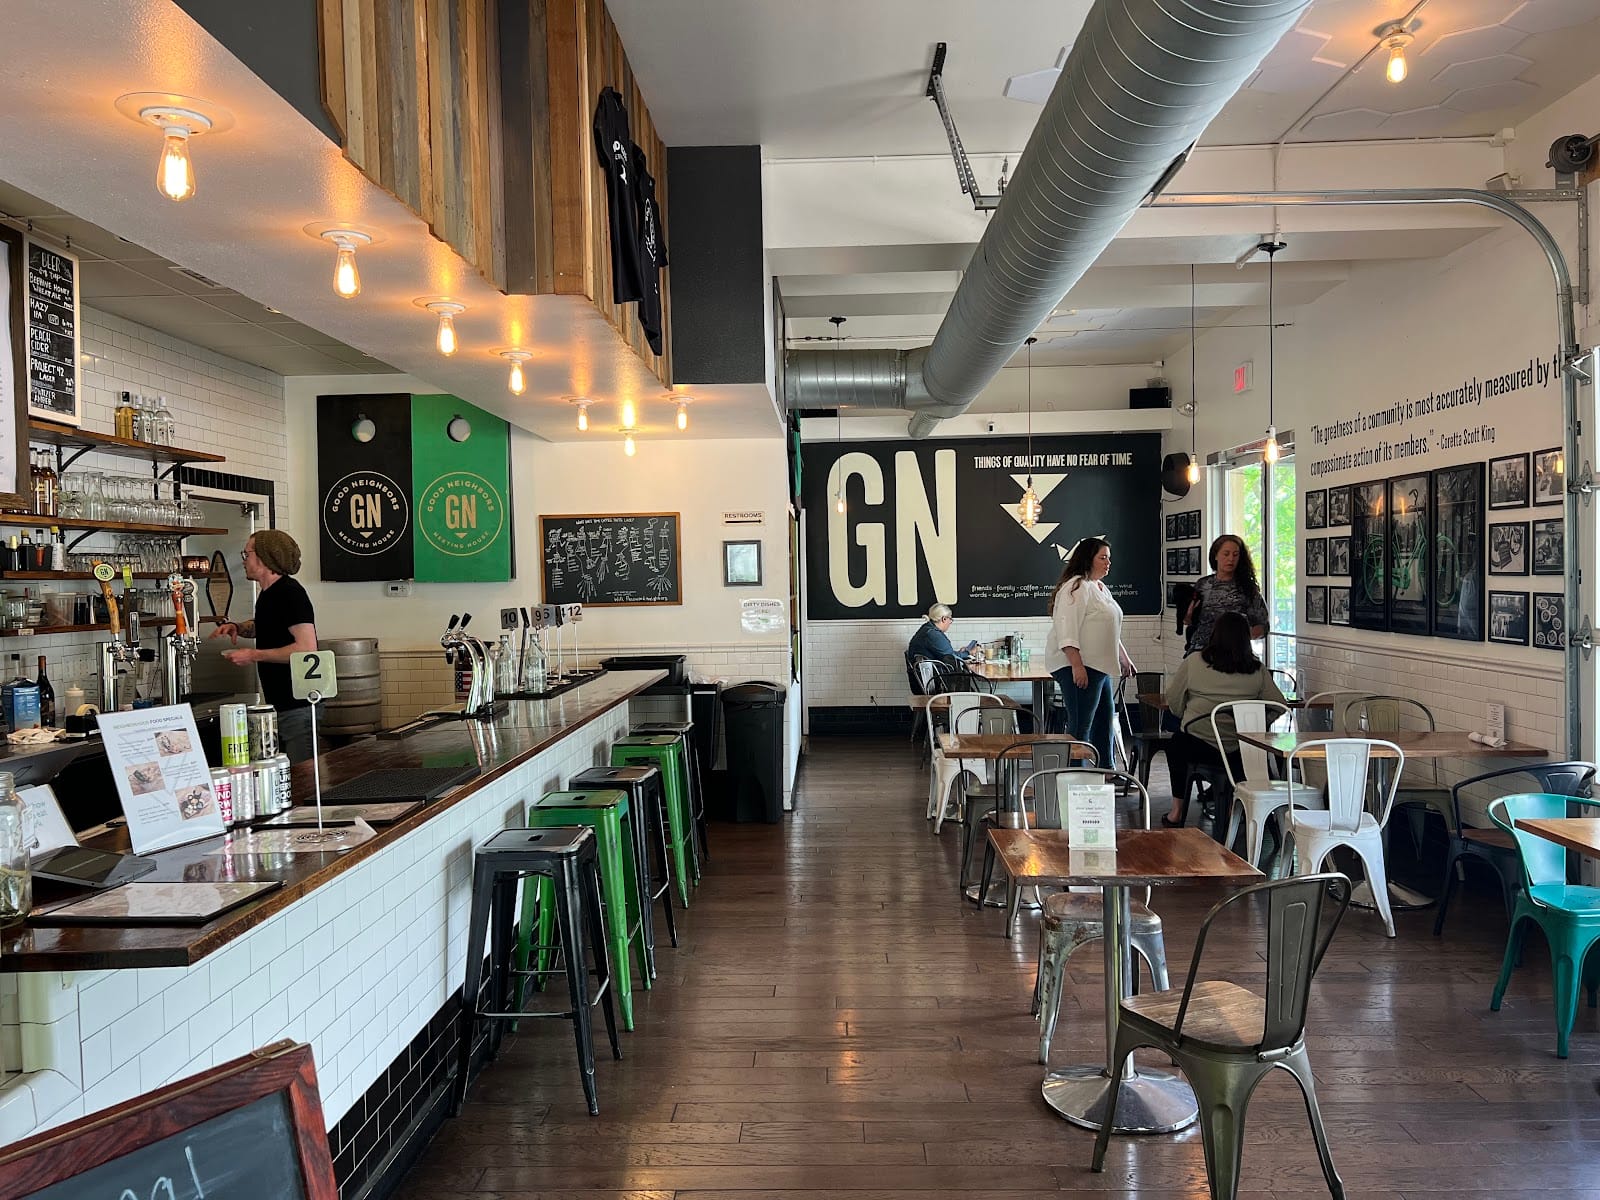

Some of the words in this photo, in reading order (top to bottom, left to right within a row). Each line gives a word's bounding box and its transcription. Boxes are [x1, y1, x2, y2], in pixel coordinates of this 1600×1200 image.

[30, 298, 49, 312] HAZY
[33, 310, 42, 320] IPA
[30, 328, 51, 344] PEACH
[31, 340, 50, 354] CIDER
[30, 358, 56, 374] PROJECT
[57, 365, 65, 377] 42
[1324, 420, 1353, 445] greatness
[1354, 412, 1361, 433] of
[1362, 416, 1367, 432] a
[1368, 402, 1404, 430] community
[1406, 399, 1413, 420] is
[1415, 392, 1434, 417] most
[1435, 376, 1482, 411] accurately
[1485, 359, 1533, 399] measured
[1536, 357, 1549, 388] by
[1310, 451, 1352, 478] compassionate
[1354, 446, 1373, 467] action
[1374, 441, 1382, 463] of
[1383, 441, 1392, 461] its
[1441, 432, 1462, 449] Coretta
[1463, 426, 1480, 445] Scott
[1481, 424, 1495, 443] King
[974, 456, 1001, 469] THINGS
[1003, 456, 1013, 468] OF
[1014, 455, 1046, 468] QUALITY
[1047, 454, 1066, 467] HAVE
[1067, 454, 1078, 466] NO
[1079, 454, 1098, 466] FEAR
[1100, 453, 1110, 465] OF
[1111, 453, 1132, 465] TIME
[332, 486, 349, 512] GOOD
[352, 479, 400, 511] NEIGHBORS
[427, 486, 445, 512] GOOD
[447, 480, 495, 512] NEIGHBORS
[350, 493, 382, 529] GN
[445, 494, 477, 529] GN
[826, 449, 958, 608] GN
[338, 530, 370, 548] MEETING
[372, 529, 395, 547] HOUSE
[433, 532, 464, 549] MEETING
[467, 531, 489, 549] HOUSE
[972, 585, 992, 593] friends
[503, 612, 516, 624] 10
[535, 610, 541, 621] 9
[568, 606, 582, 616] 12
[303, 654, 321, 679] 2
